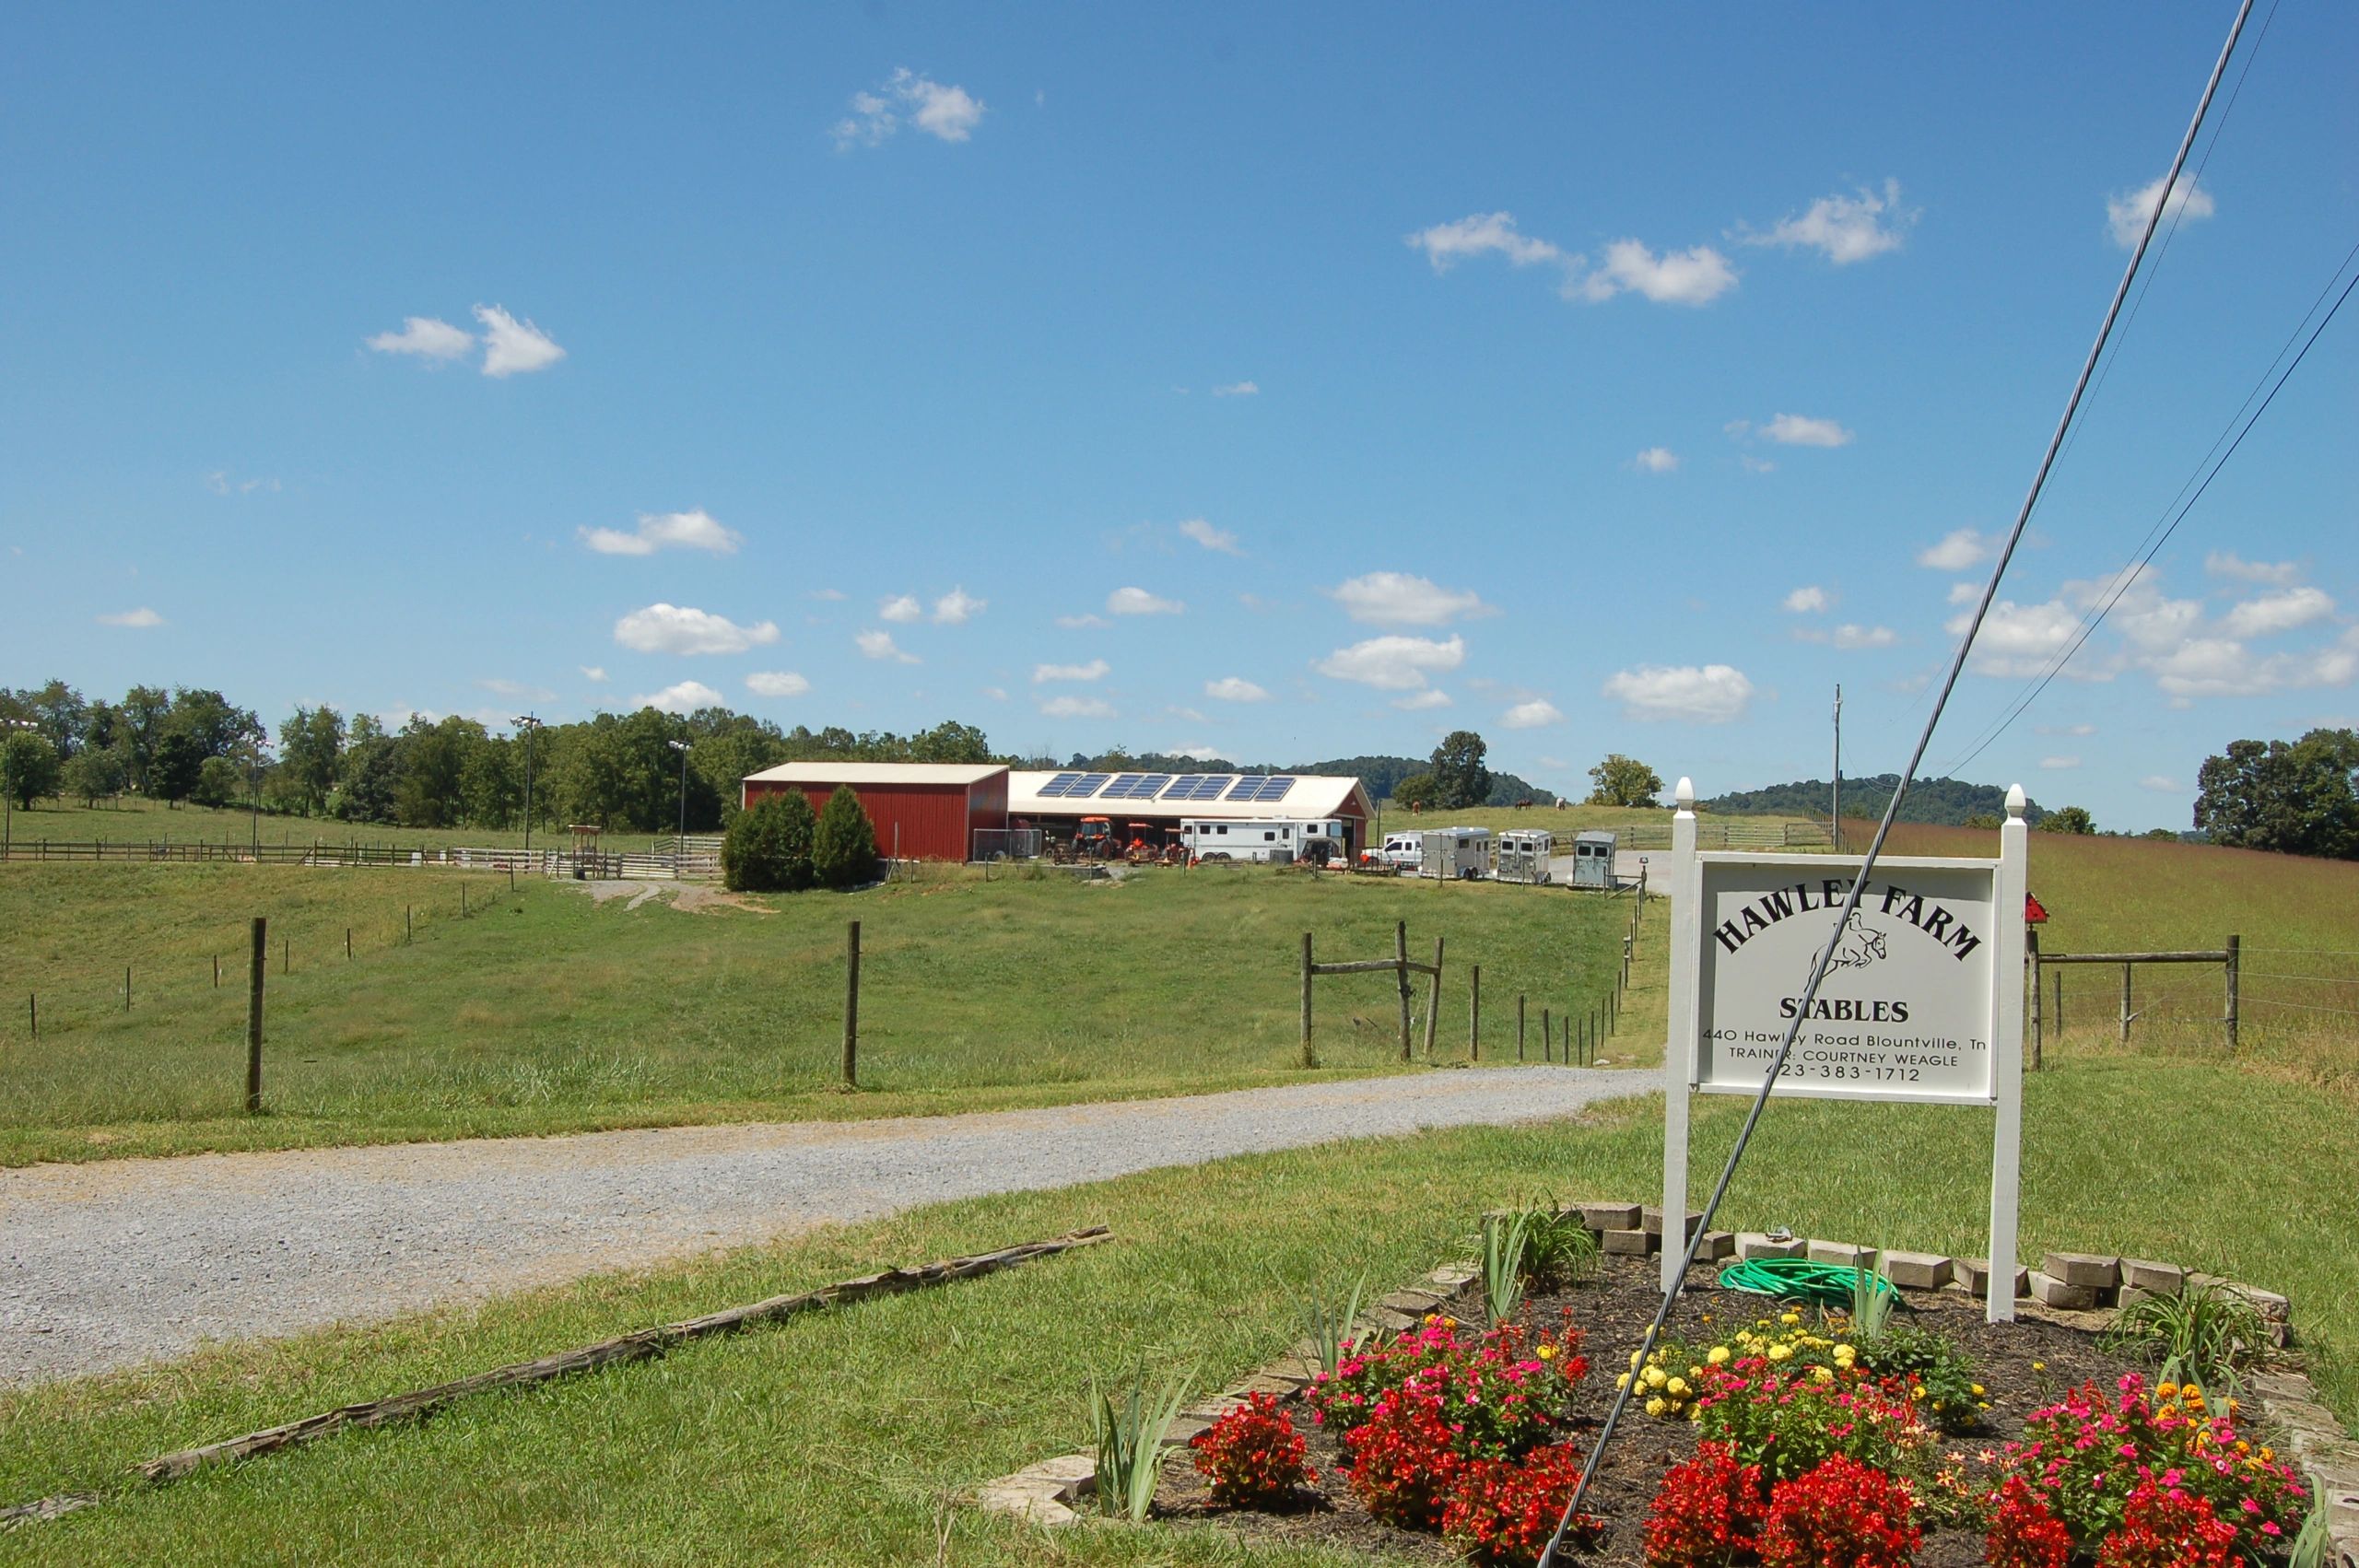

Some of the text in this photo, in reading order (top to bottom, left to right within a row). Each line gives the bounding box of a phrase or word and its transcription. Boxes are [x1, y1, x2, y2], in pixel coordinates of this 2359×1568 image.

[1880, 884, 1982, 962] FARM
[1702, 1029, 1738, 1041] 440
[1814, 1033, 1860, 1047] Road
[1867, 1036, 1962, 1051] Blountville,
[1969, 1038, 1987, 1050] Tn
[1802, 1050, 1887, 1064] COURTNEY
[1895, 1054, 1959, 1067] WEAGLE
